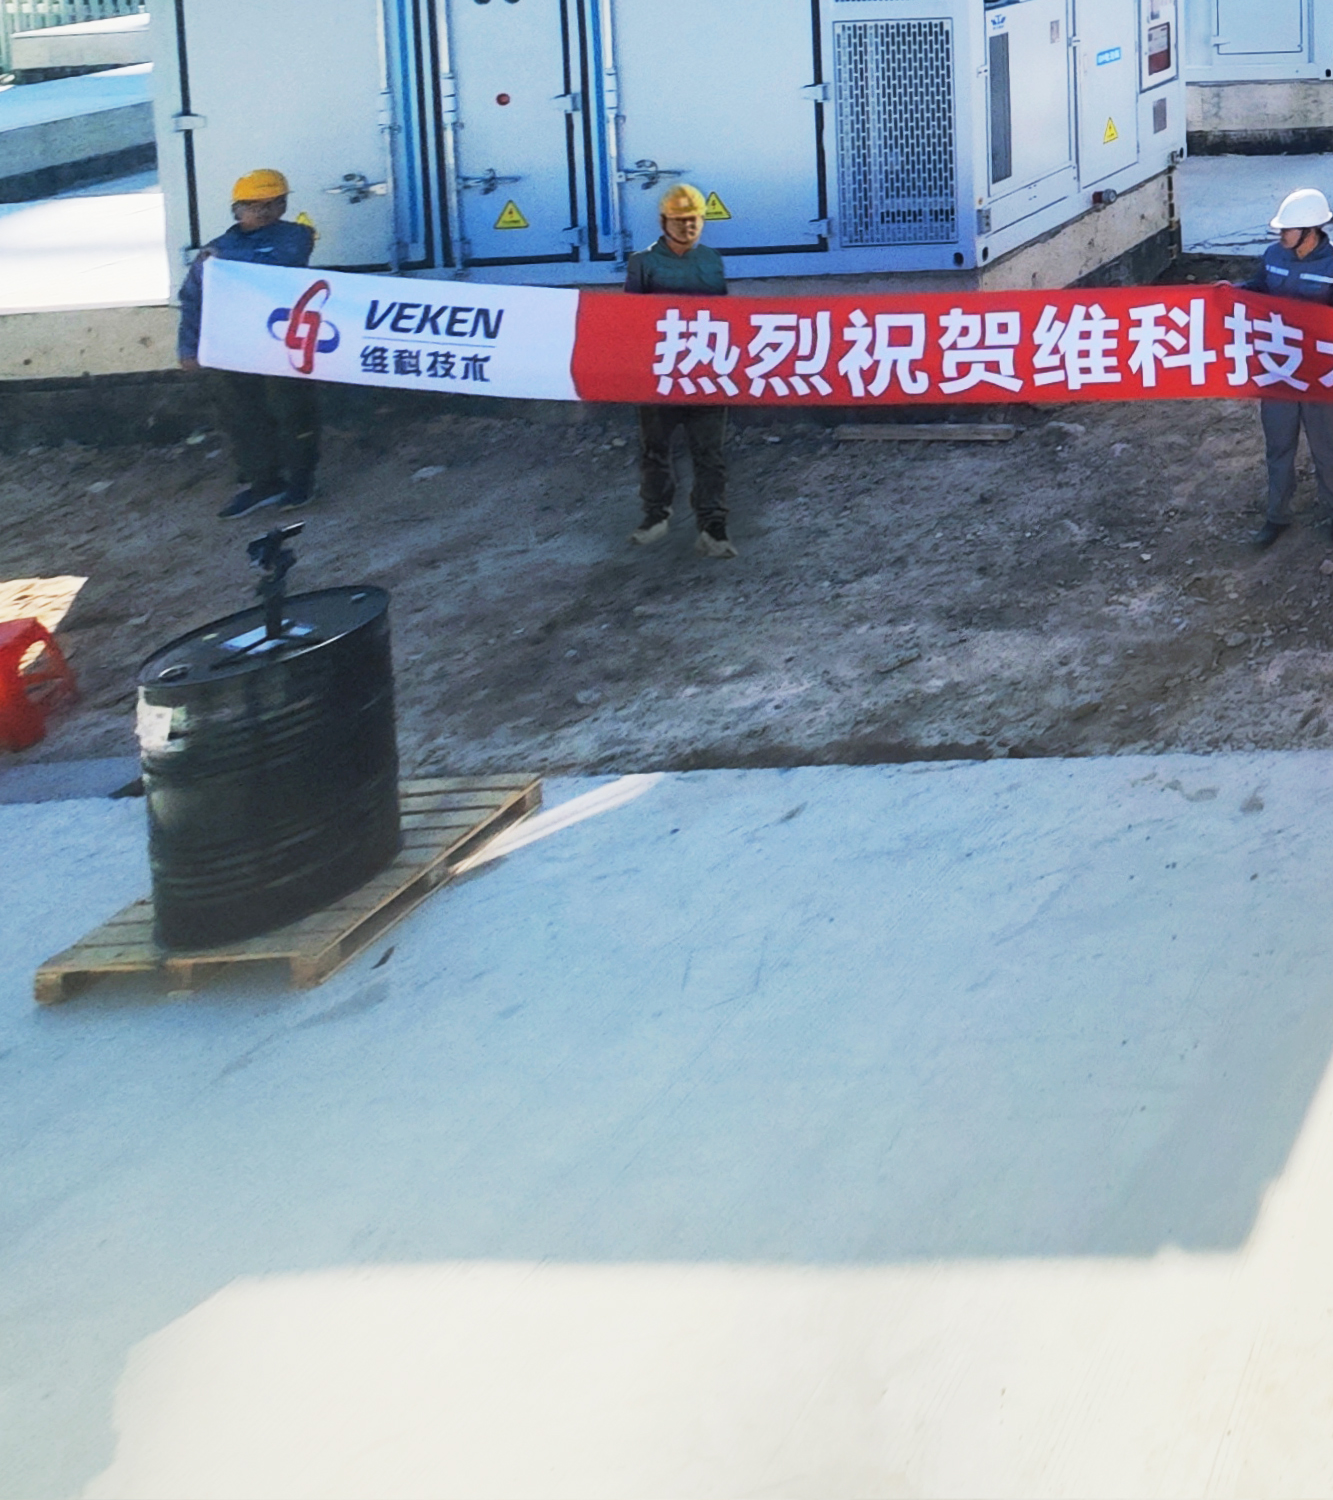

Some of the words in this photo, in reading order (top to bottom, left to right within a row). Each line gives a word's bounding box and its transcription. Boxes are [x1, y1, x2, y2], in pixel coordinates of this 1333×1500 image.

[364, 300, 504, 340] VEKEN
[359, 345, 492, 383] 维科技术
